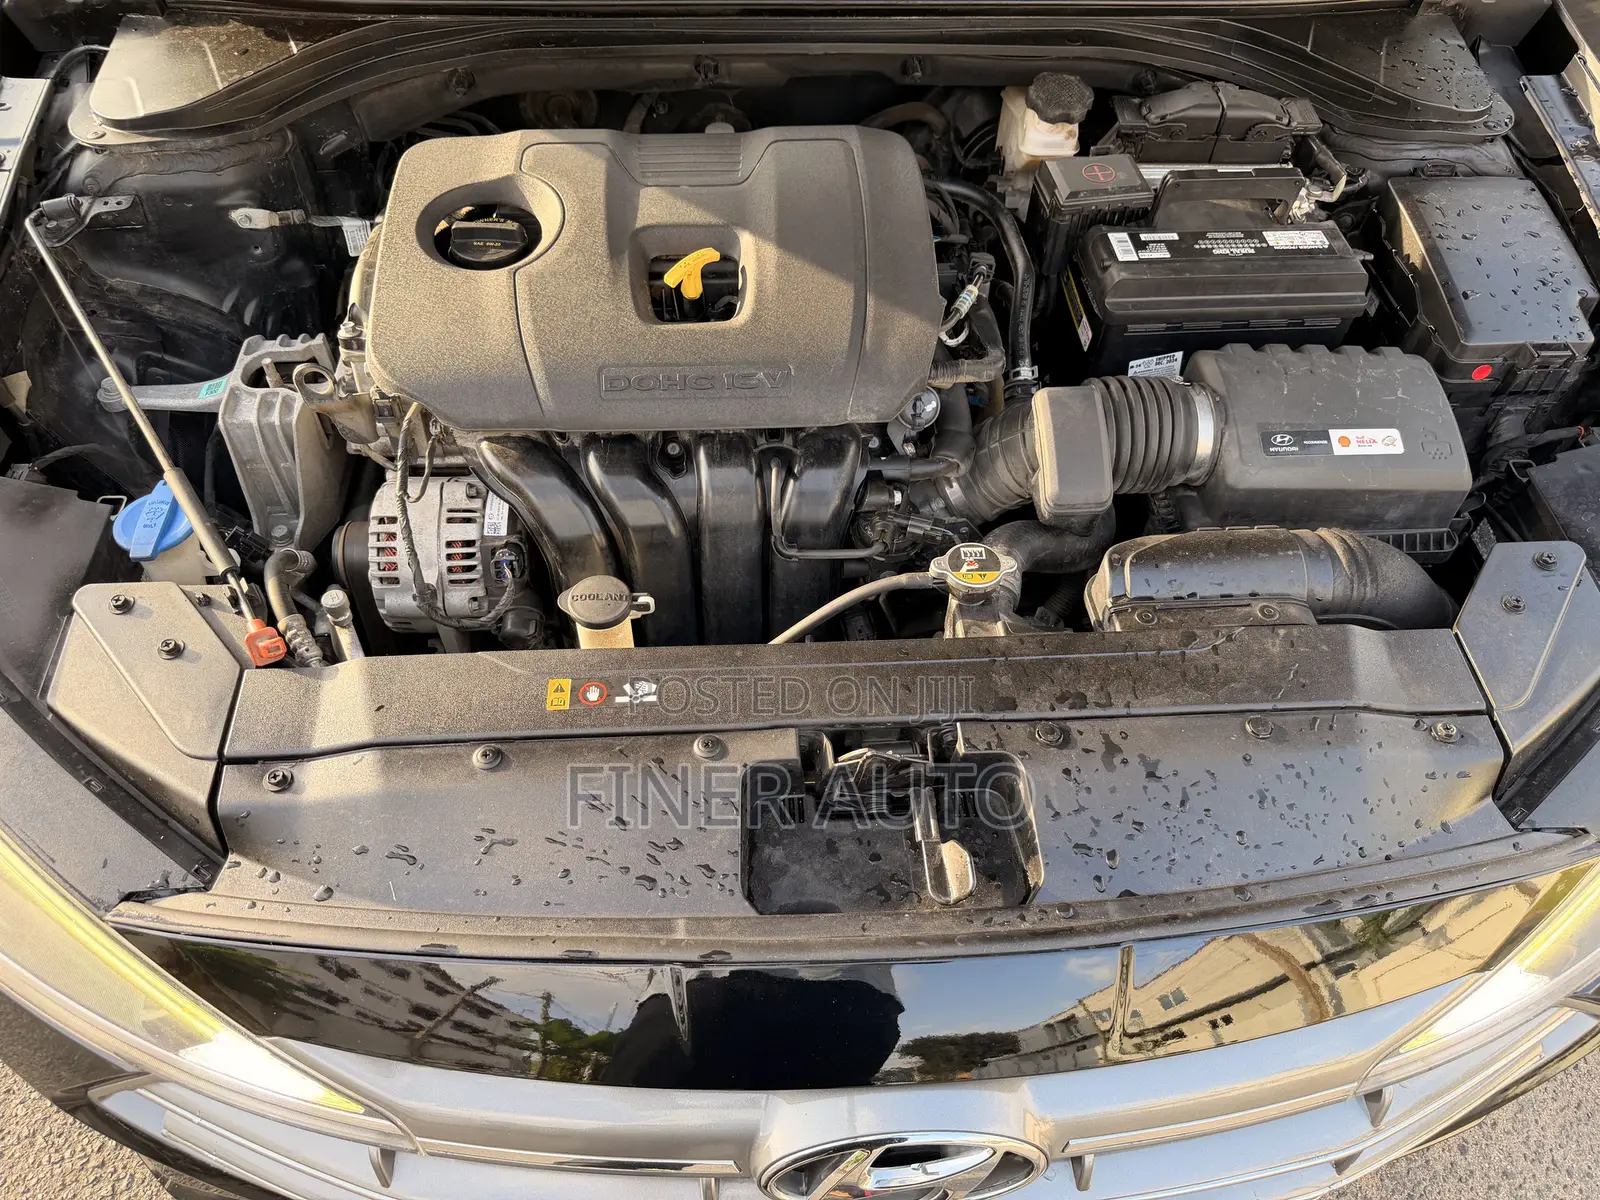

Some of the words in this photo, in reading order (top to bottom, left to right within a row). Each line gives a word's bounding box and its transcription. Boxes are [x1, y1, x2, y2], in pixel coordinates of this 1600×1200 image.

[602, 372, 715, 391] DOHC
[723, 370, 788, 390] 16V
[571, 592, 628, 602] COOLANT
